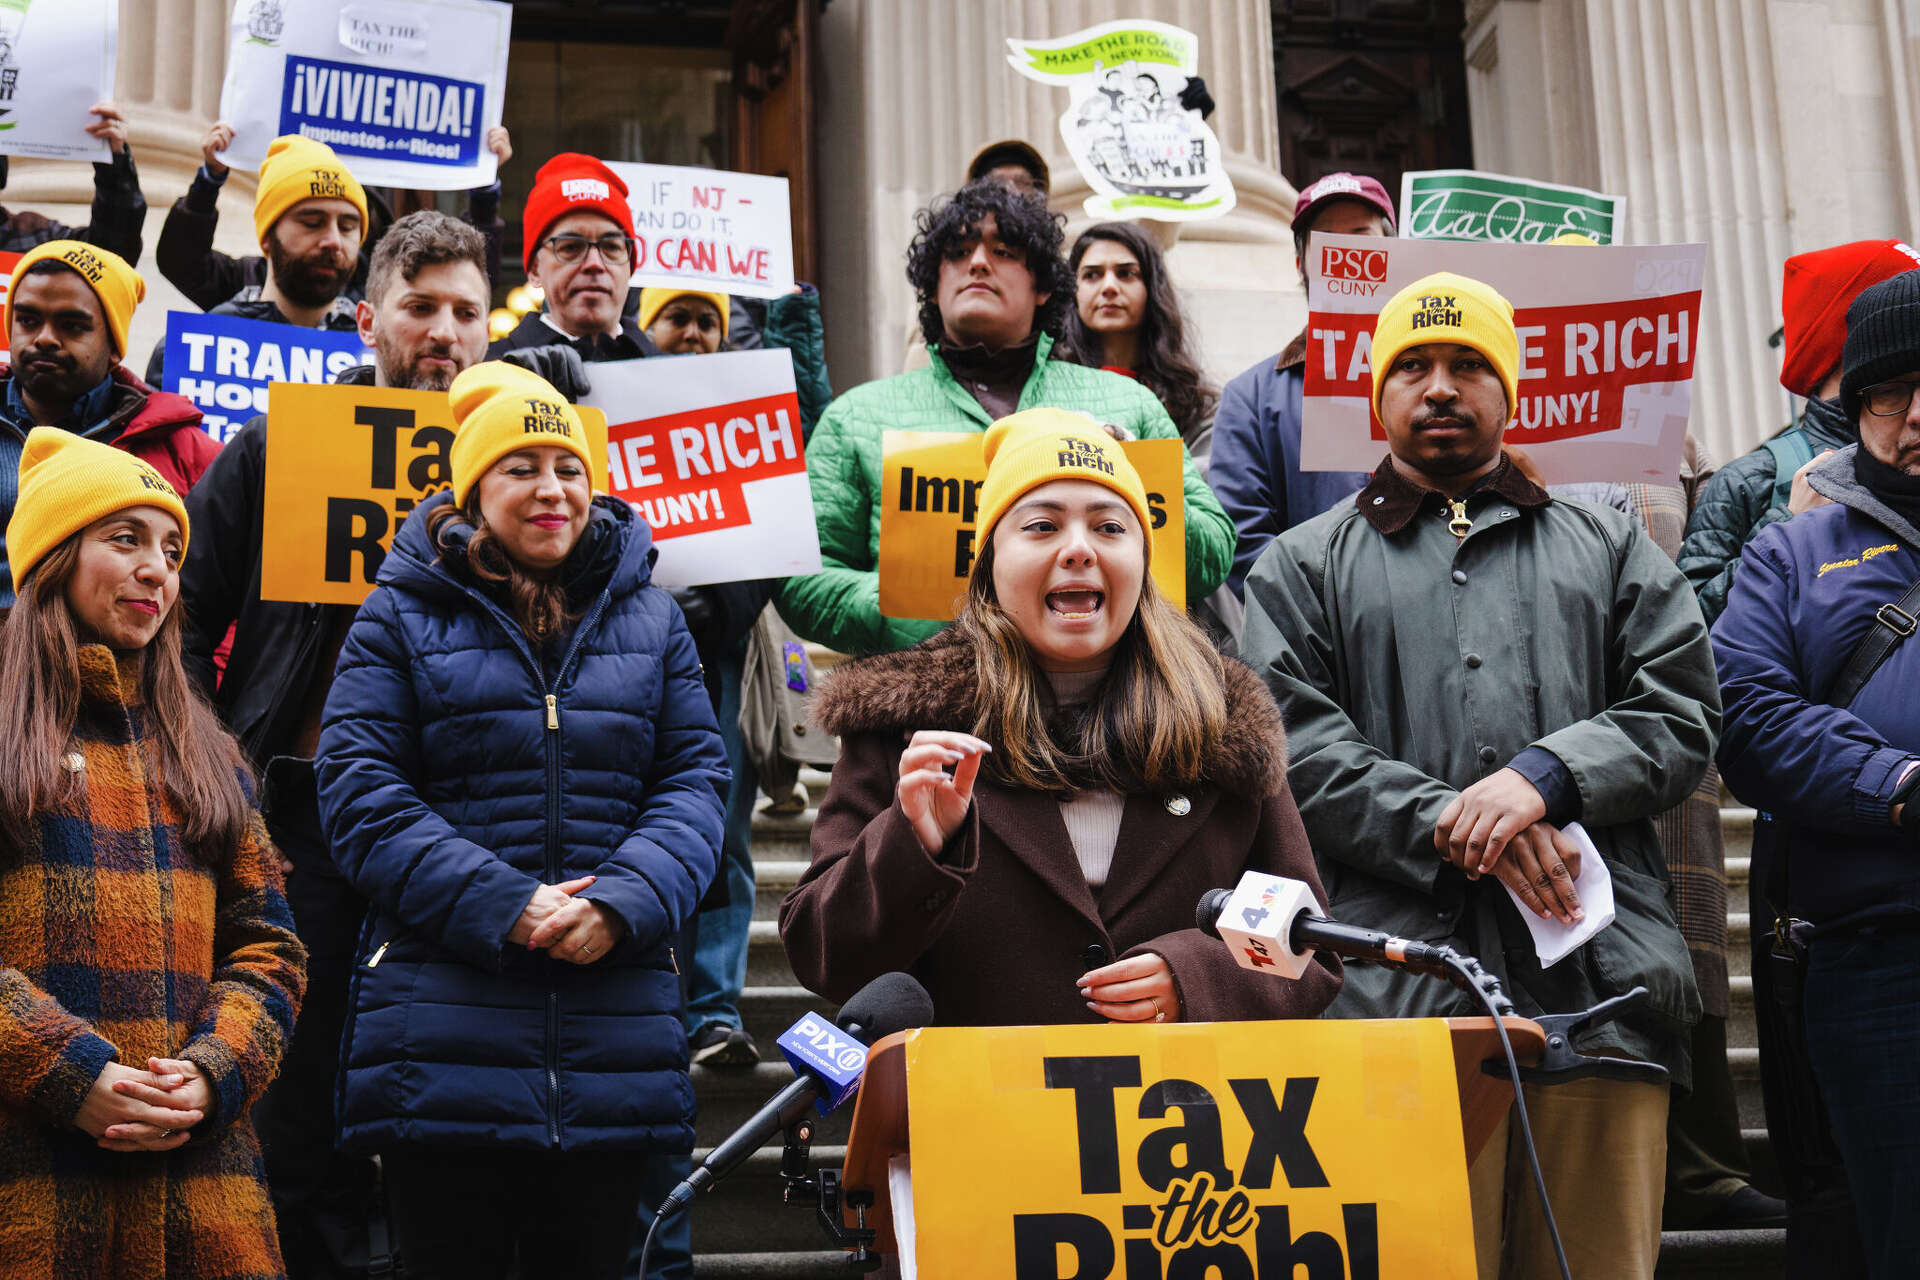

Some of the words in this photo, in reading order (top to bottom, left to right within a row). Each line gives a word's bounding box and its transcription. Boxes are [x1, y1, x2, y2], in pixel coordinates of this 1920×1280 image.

[1044, 47, 1093, 66] MAKE
[1096, 33, 1129, 53] THE
[1134, 33, 1186, 52] ROAD
[1110, 48, 1143, 61] NEW
[291, 63, 476, 138] ¡VIVIENDA!
[409, 137, 460, 160] Ricos!
[652, 182, 672, 205] IF
[693, 186, 726, 211] NJ
[637, 210, 665, 230] AN
[672, 211, 702, 230] DO
[656, 237, 717, 273] CAN
[727, 244, 769, 280] WE
[1323, 247, 1386, 281] PSC
[1327, 279, 1379, 297] CUNY
[1417, 295, 1456, 310] Tax
[1412, 308, 1462, 330] Rich!
[181, 332, 376, 385] TRANS
[1312, 328, 1373, 381] TA
[1564, 310, 1690, 377] RICH
[524, 399, 563, 417] Tax
[1505, 389, 1600, 430] UNY!
[523, 415, 571, 438] Rich!
[354, 405, 456, 493] Ta
[668, 408, 798, 480] RICH
[1060, 437, 1105, 456] Tax
[1057, 450, 1115, 476] Rich!
[1816, 558, 1860, 578] Senator
[1861, 544, 1899, 562] Rivera
[1241, 906, 1270, 929] 4
[1043, 1055, 1331, 1195] Tax
[1157, 1177, 1254, 1248] the
